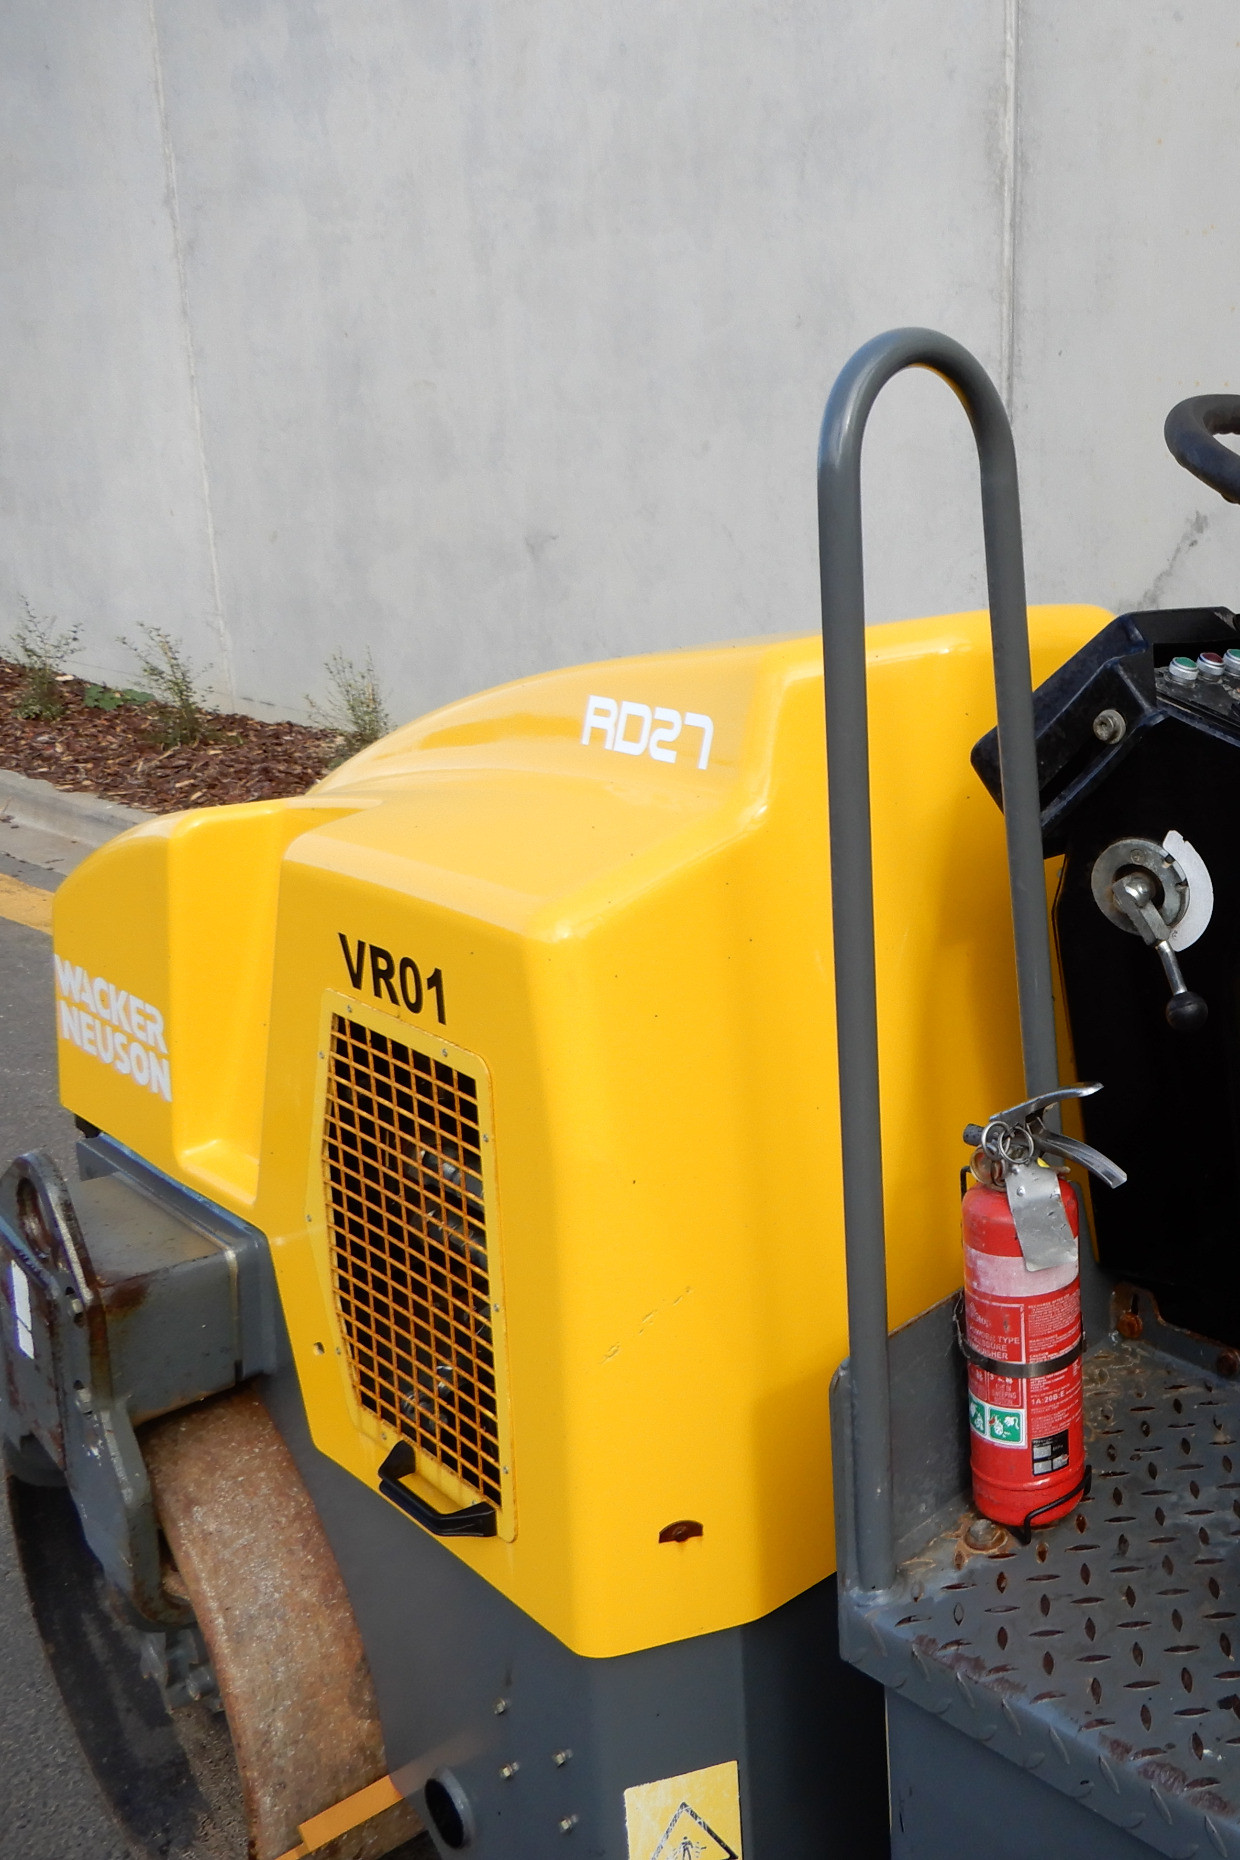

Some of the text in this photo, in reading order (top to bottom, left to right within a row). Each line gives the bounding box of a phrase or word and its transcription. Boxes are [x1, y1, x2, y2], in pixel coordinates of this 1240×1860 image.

[580, 694, 715, 770] RD27
[54, 953, 168, 1055] WACKER
[337, 932, 447, 1026] VR01
[59, 999, 173, 1103] NEUSON
[997, 1335, 1020, 1345] TYPE
